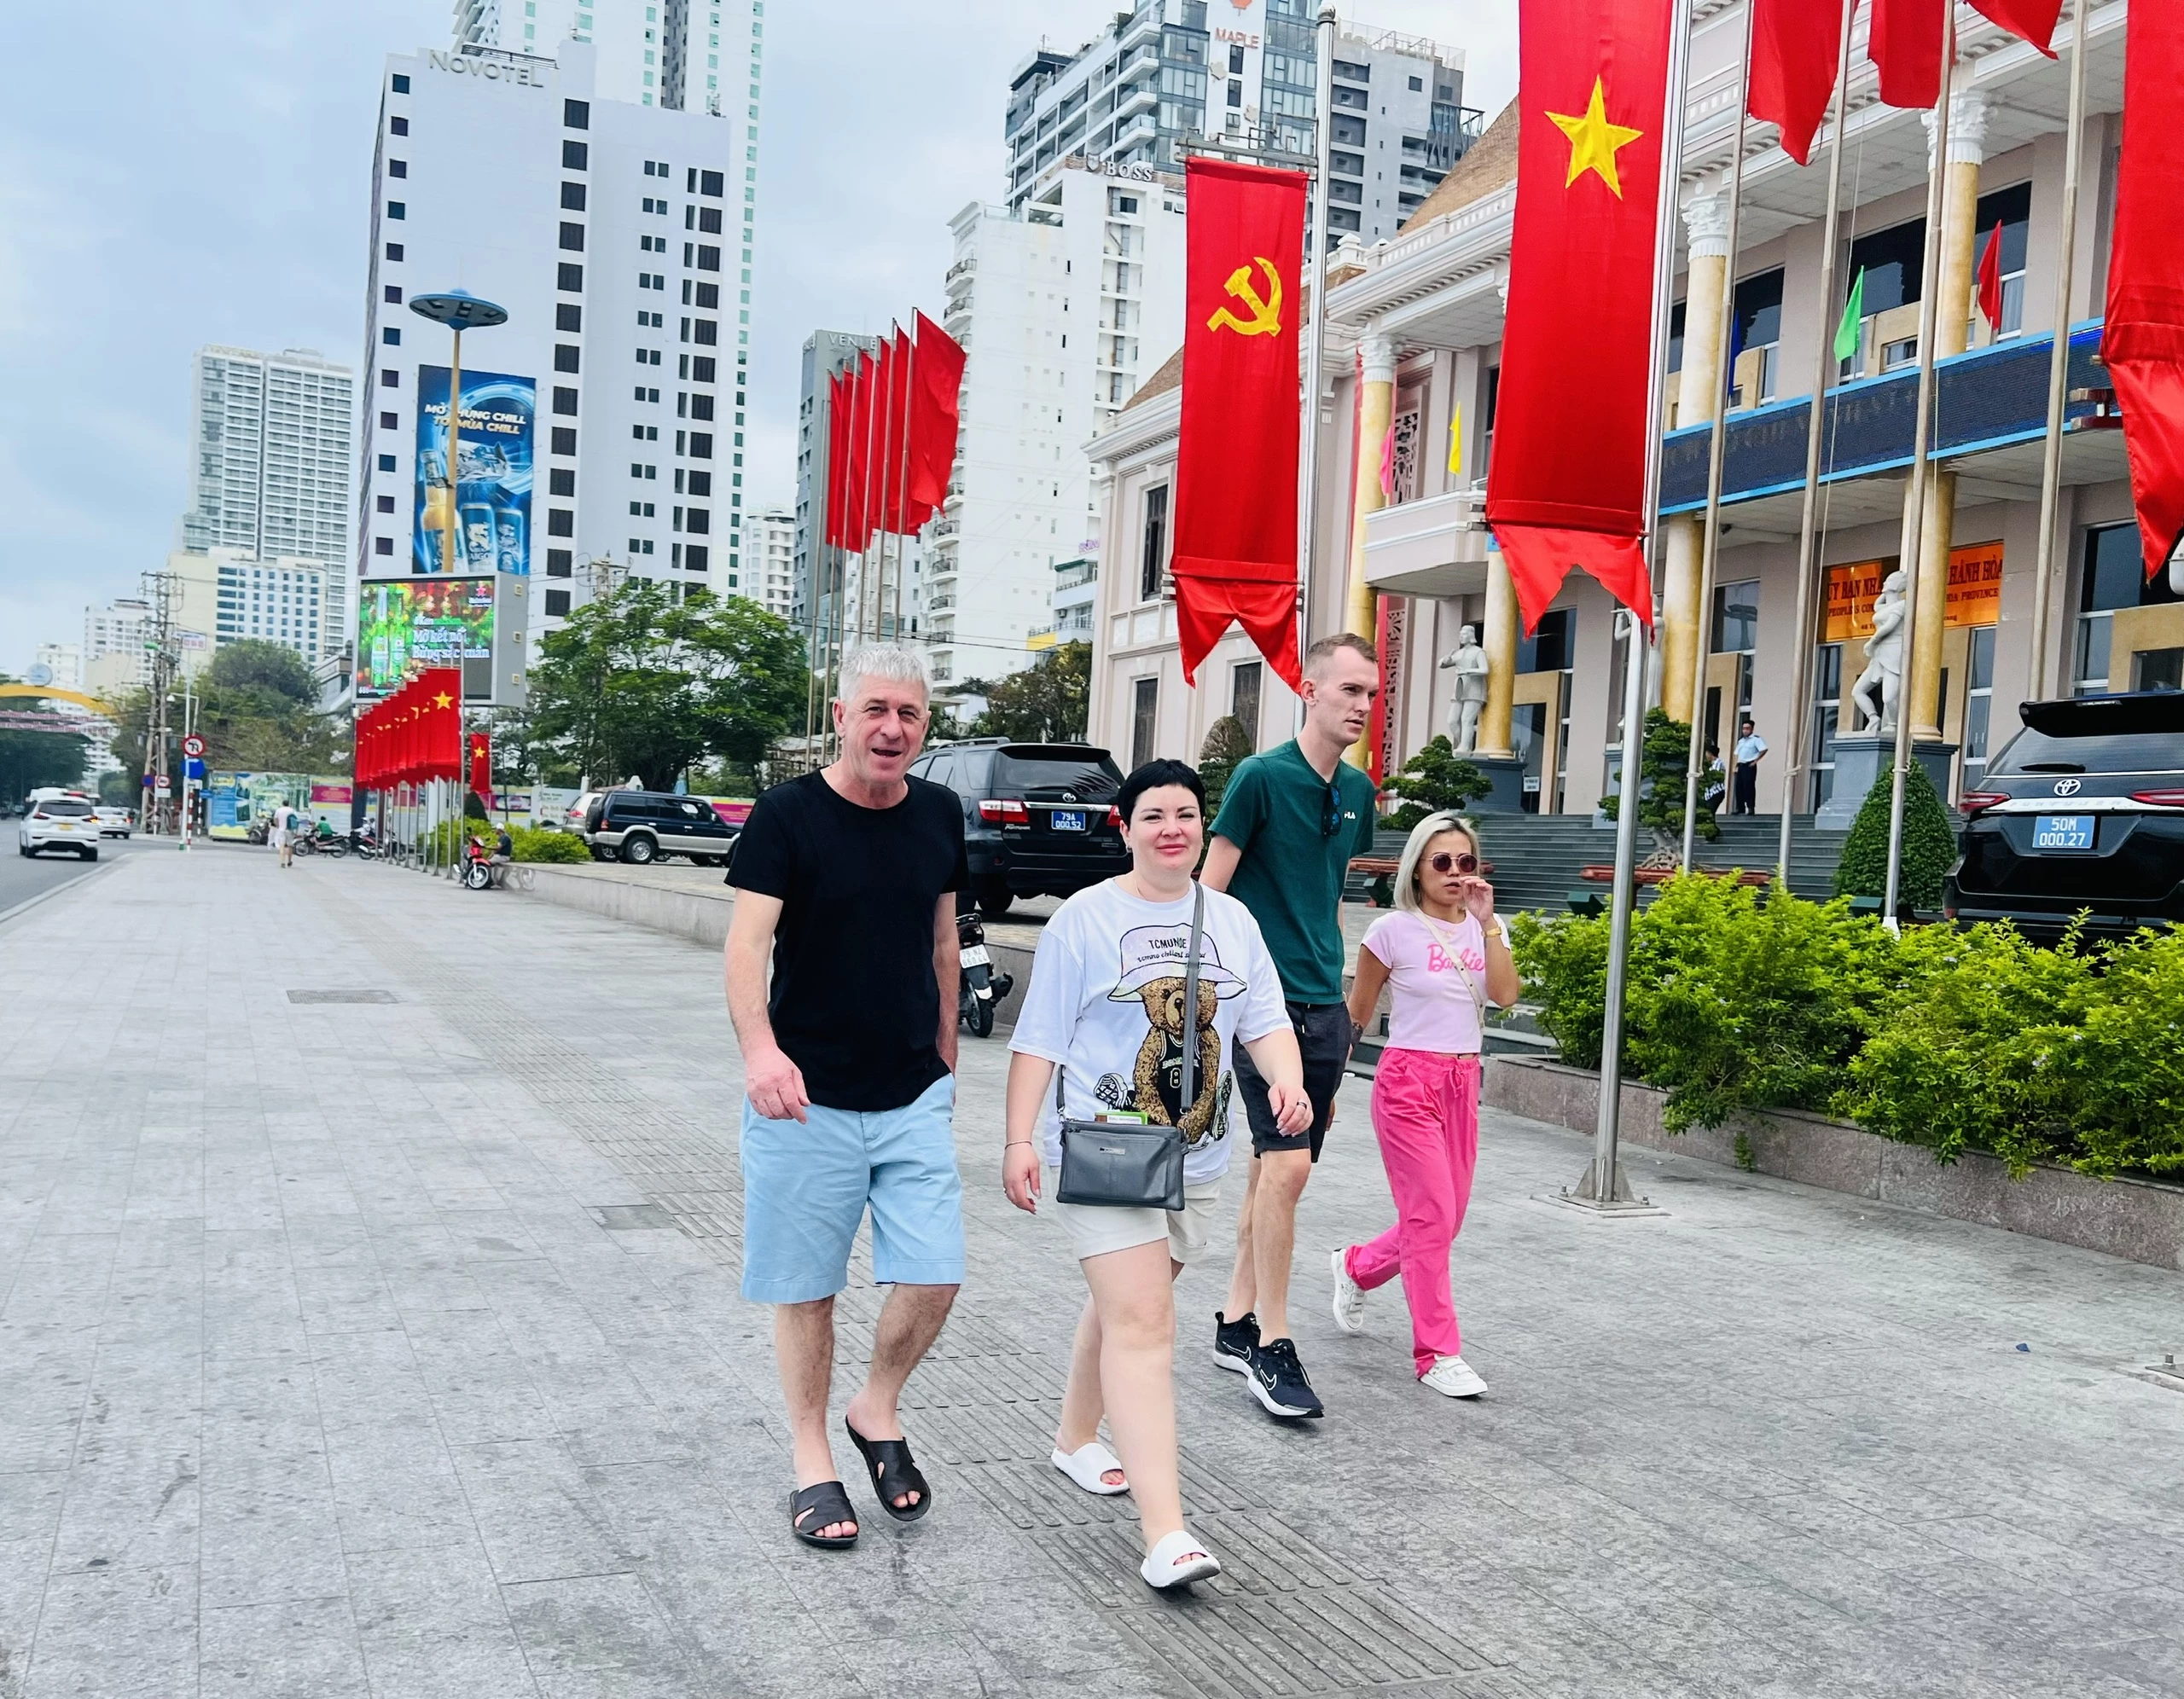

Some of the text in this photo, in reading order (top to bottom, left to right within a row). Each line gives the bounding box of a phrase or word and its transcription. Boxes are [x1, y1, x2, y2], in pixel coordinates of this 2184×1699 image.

[1215, 26, 1259, 49] MAPLE
[428, 49, 543, 88] NOVOTEL
[1106, 160, 1153, 182] BOSS
[485, 422, 520, 434] CHILL
[492, 412, 526, 425] CHILL
[1841, 579, 1862, 599] BAN
[1948, 559, 1981, 586] HÁNH
[1828, 605, 1860, 617] PEOPLES
[1961, 588, 1999, 600] PROVINCE
[1054, 820, 1082, 829] 000.52
[1060, 813, 1077, 821] 79A
[2050, 818, 2077, 832] 50M
[2039, 832, 2087, 847] 000.27
[1427, 942, 1485, 972] Babie
[1170, 1067, 1182, 1088] 8
